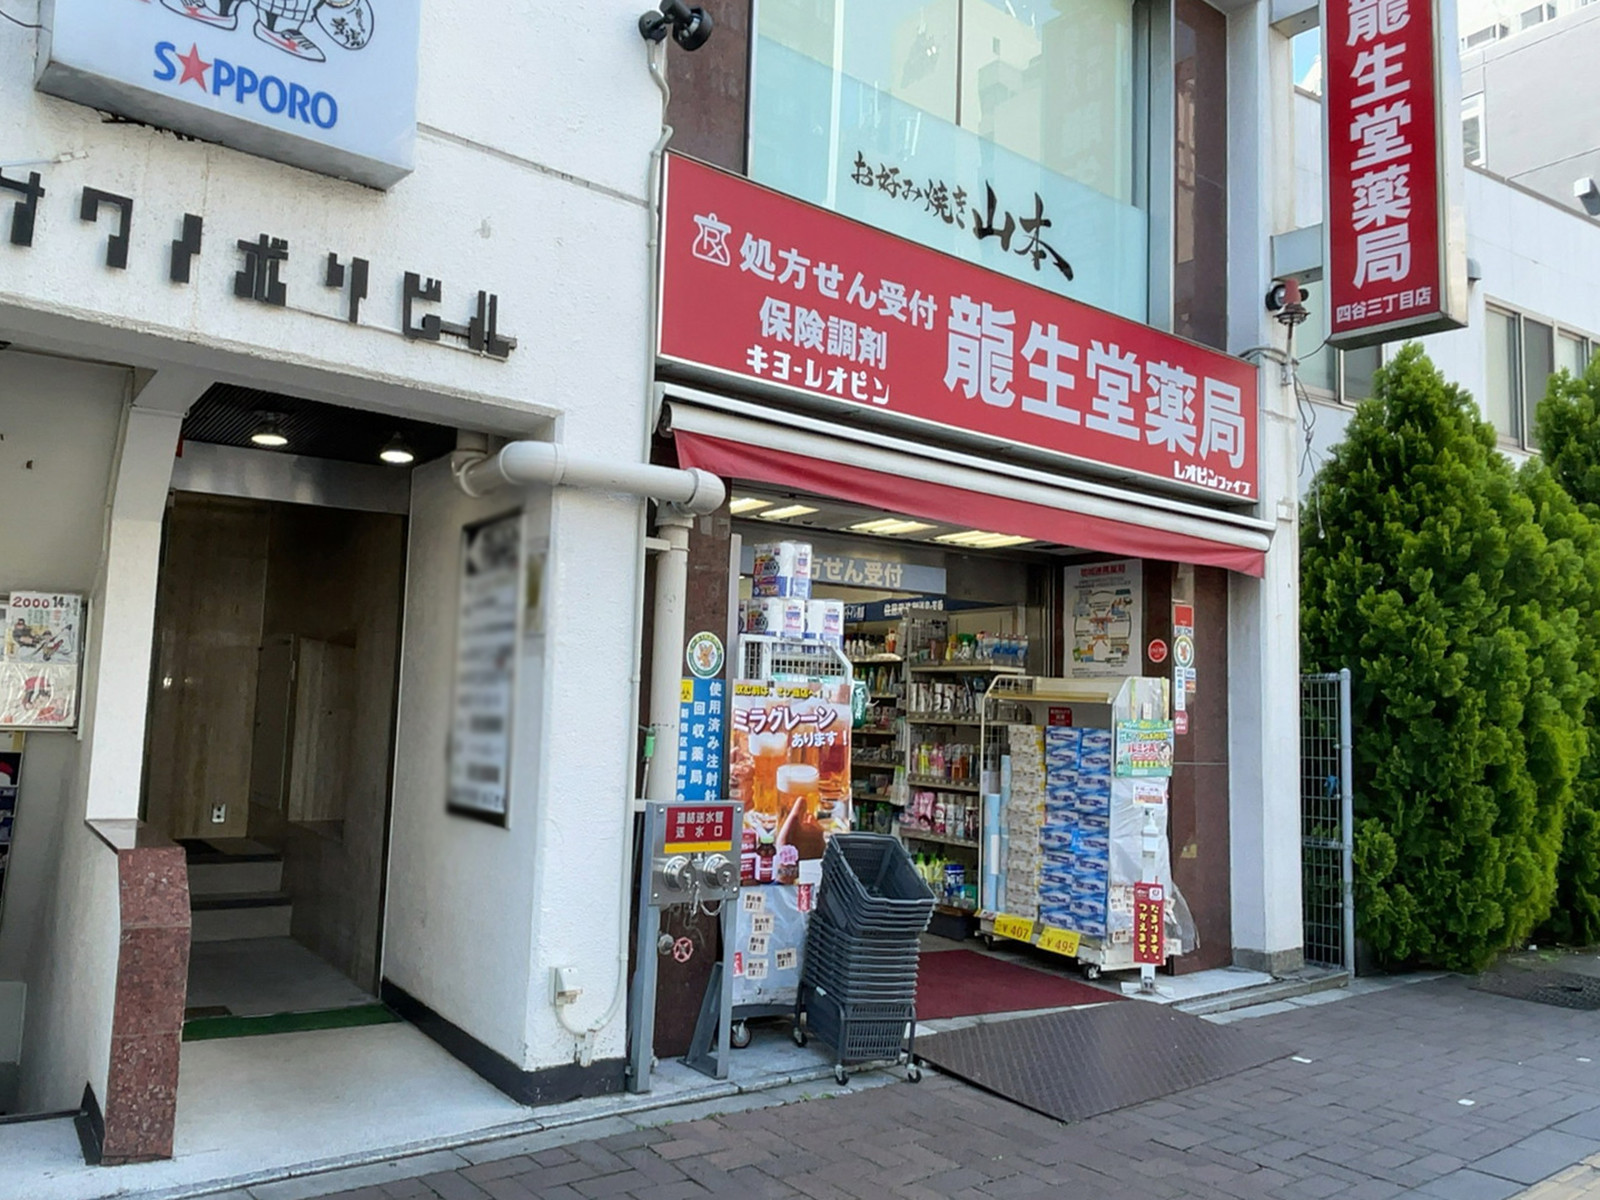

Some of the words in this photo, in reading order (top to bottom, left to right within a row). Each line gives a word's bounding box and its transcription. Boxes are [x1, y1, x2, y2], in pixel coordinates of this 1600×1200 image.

[851, 151, 968, 229] お好み焼き
[972, 181, 1074, 281] 山本
[740, 232, 938, 330] 処方せん受付
[1336, 285, 1432, 324] 四谷三丁目店
[759, 296, 888, 370] 保険調剤
[943, 294, 1246, 469] 龍生堂薬局
[12, 596, 50, 609] 2000
[690, 701, 706, 785] 回収薬局
[704, 681, 722, 801] 使用済み注射針
[733, 705, 838, 735] ミラグレーン
[675, 824, 723, 839] 送水口
